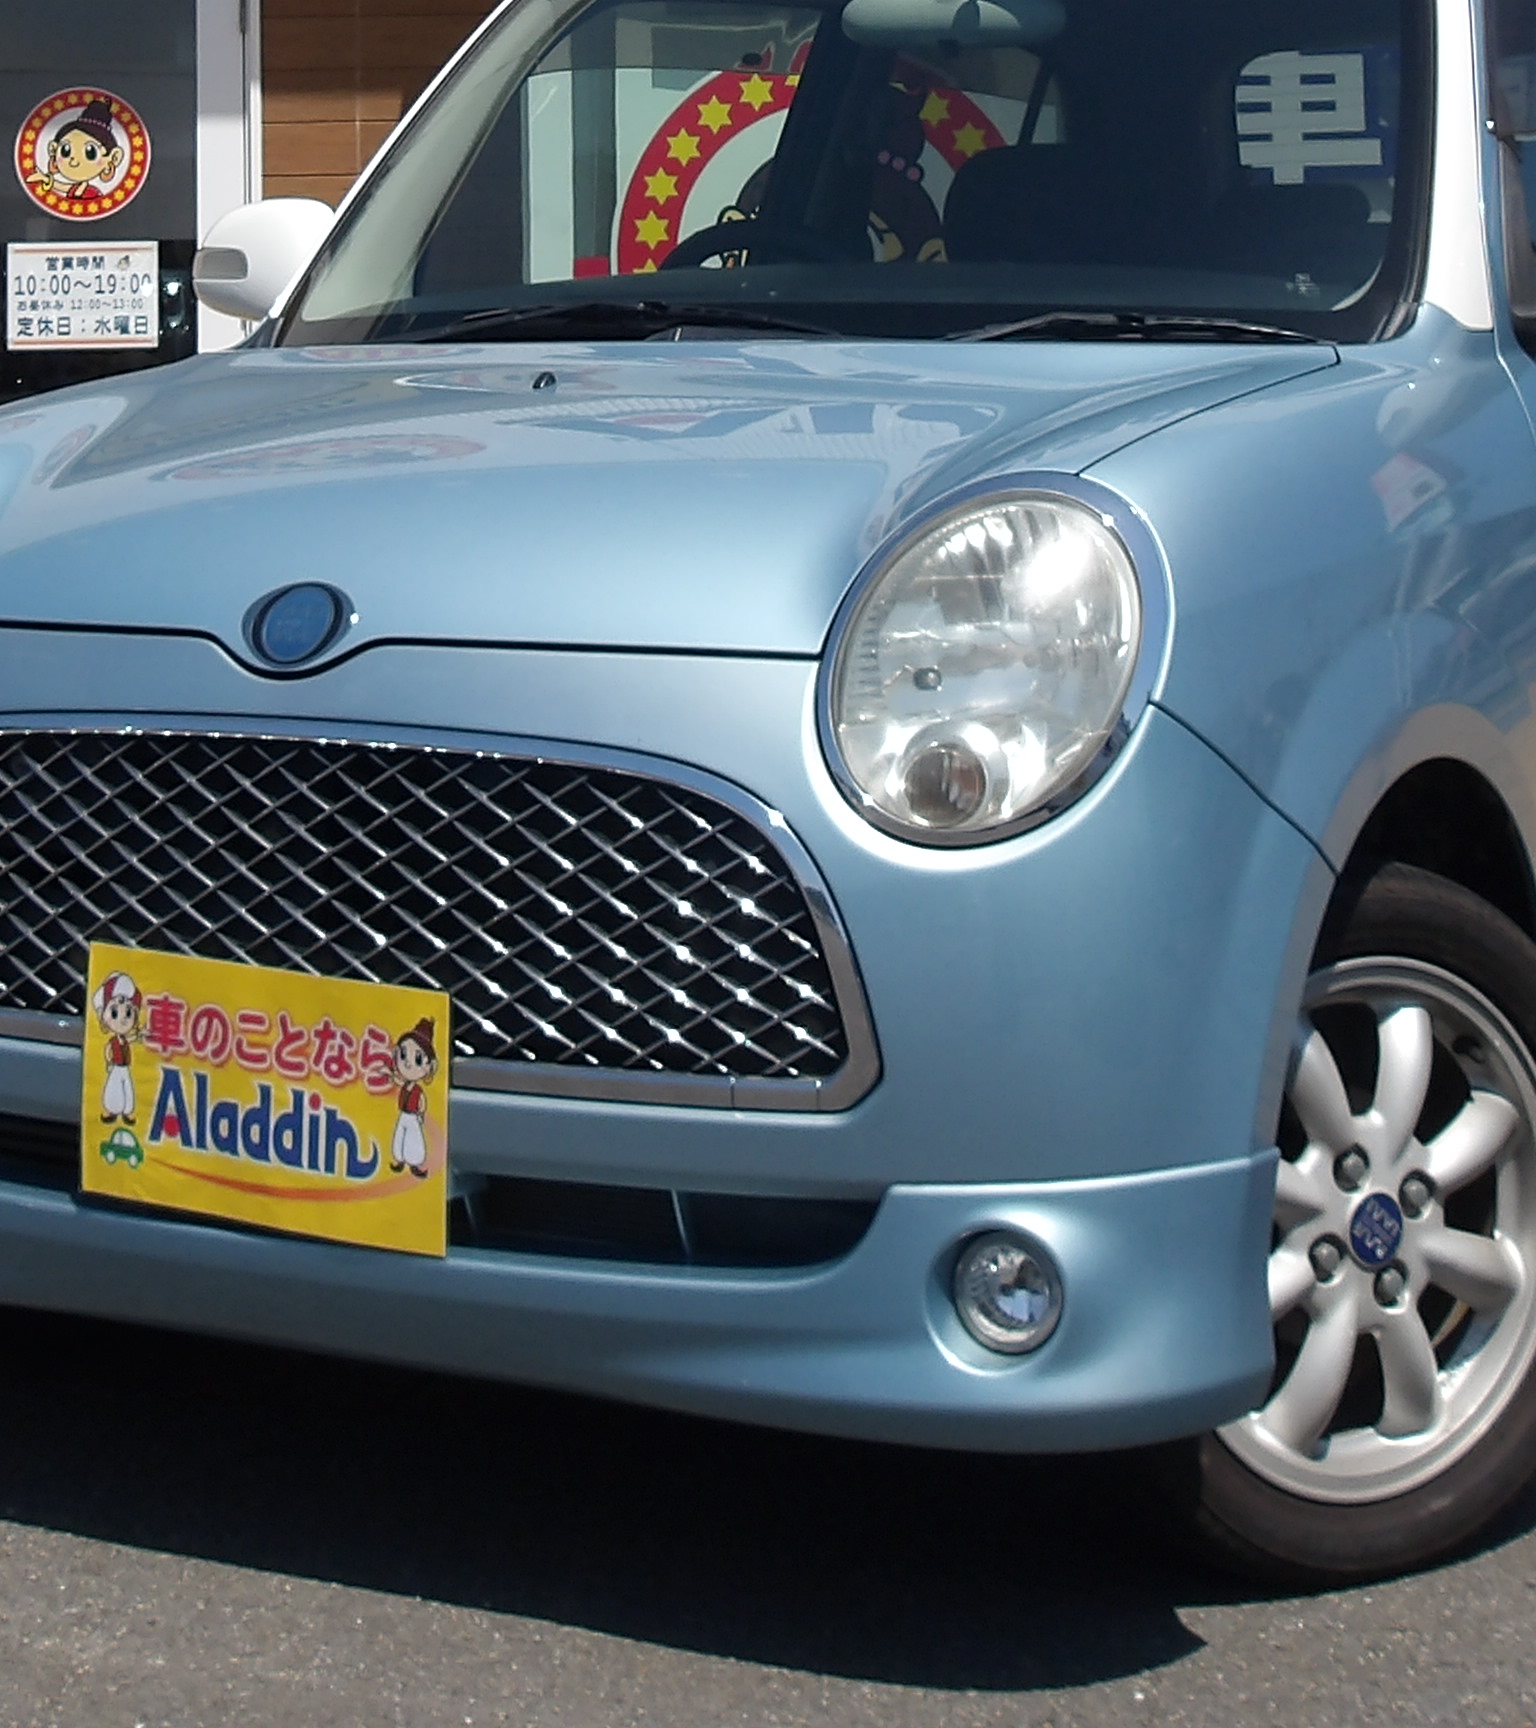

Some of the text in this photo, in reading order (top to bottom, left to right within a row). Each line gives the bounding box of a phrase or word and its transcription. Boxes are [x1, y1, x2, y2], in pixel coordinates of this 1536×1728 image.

[45, 256, 106, 271] 営業時間
[144, 994, 395, 1090] 車のことなら
[148, 1066, 380, 1180] Aladdin
